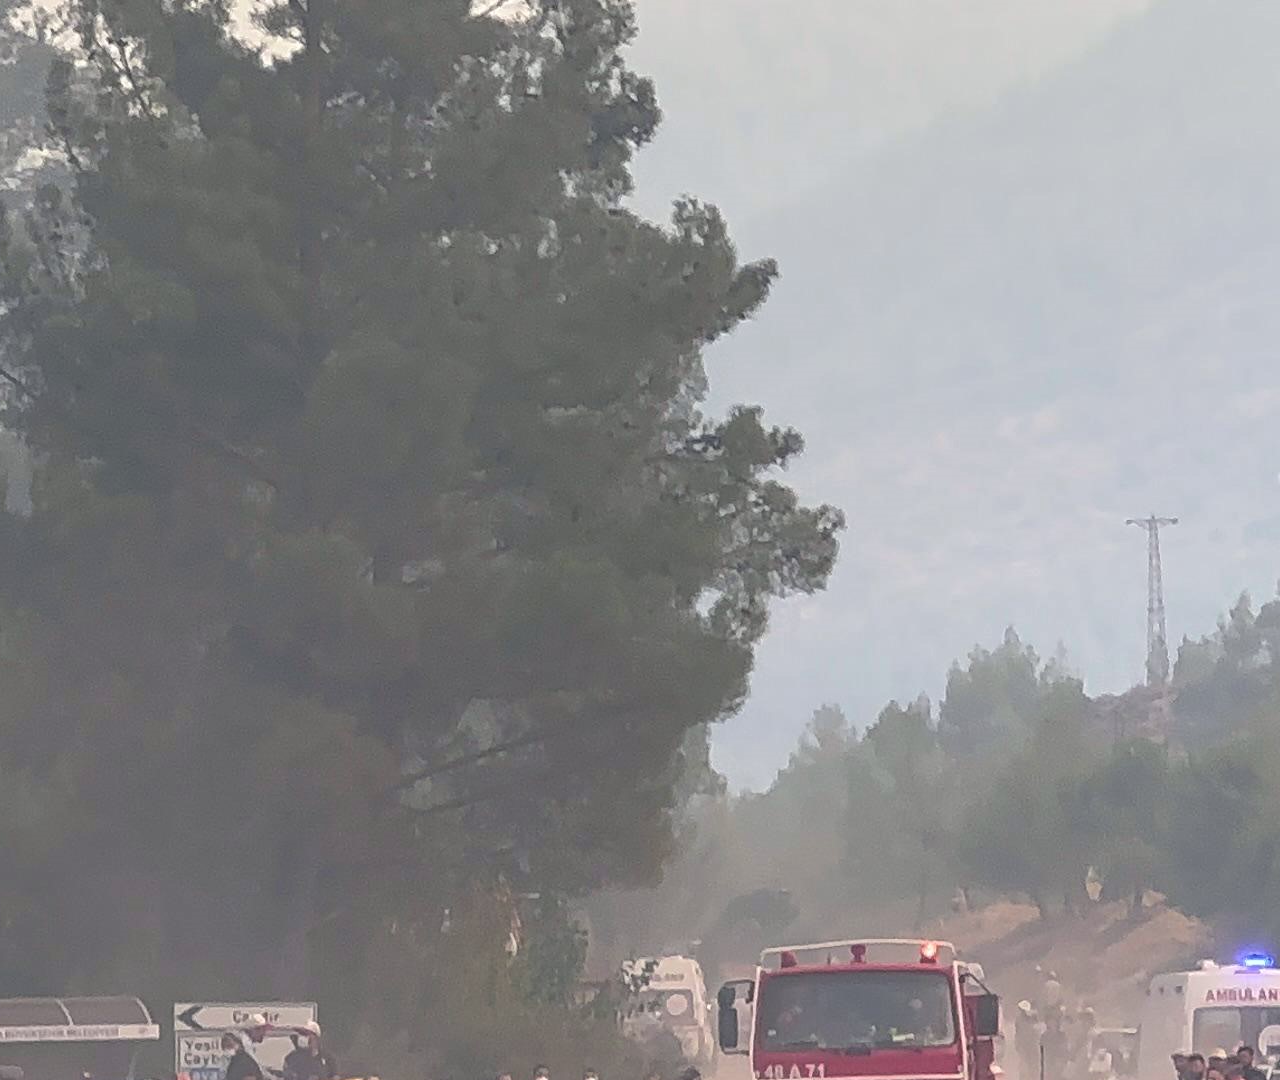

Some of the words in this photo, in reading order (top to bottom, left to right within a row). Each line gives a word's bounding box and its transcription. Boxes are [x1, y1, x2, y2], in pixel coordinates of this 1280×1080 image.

[764, 1064, 784, 1080] 48
[789, 1063, 801, 1080] A
[805, 1063, 825, 1079] 71
